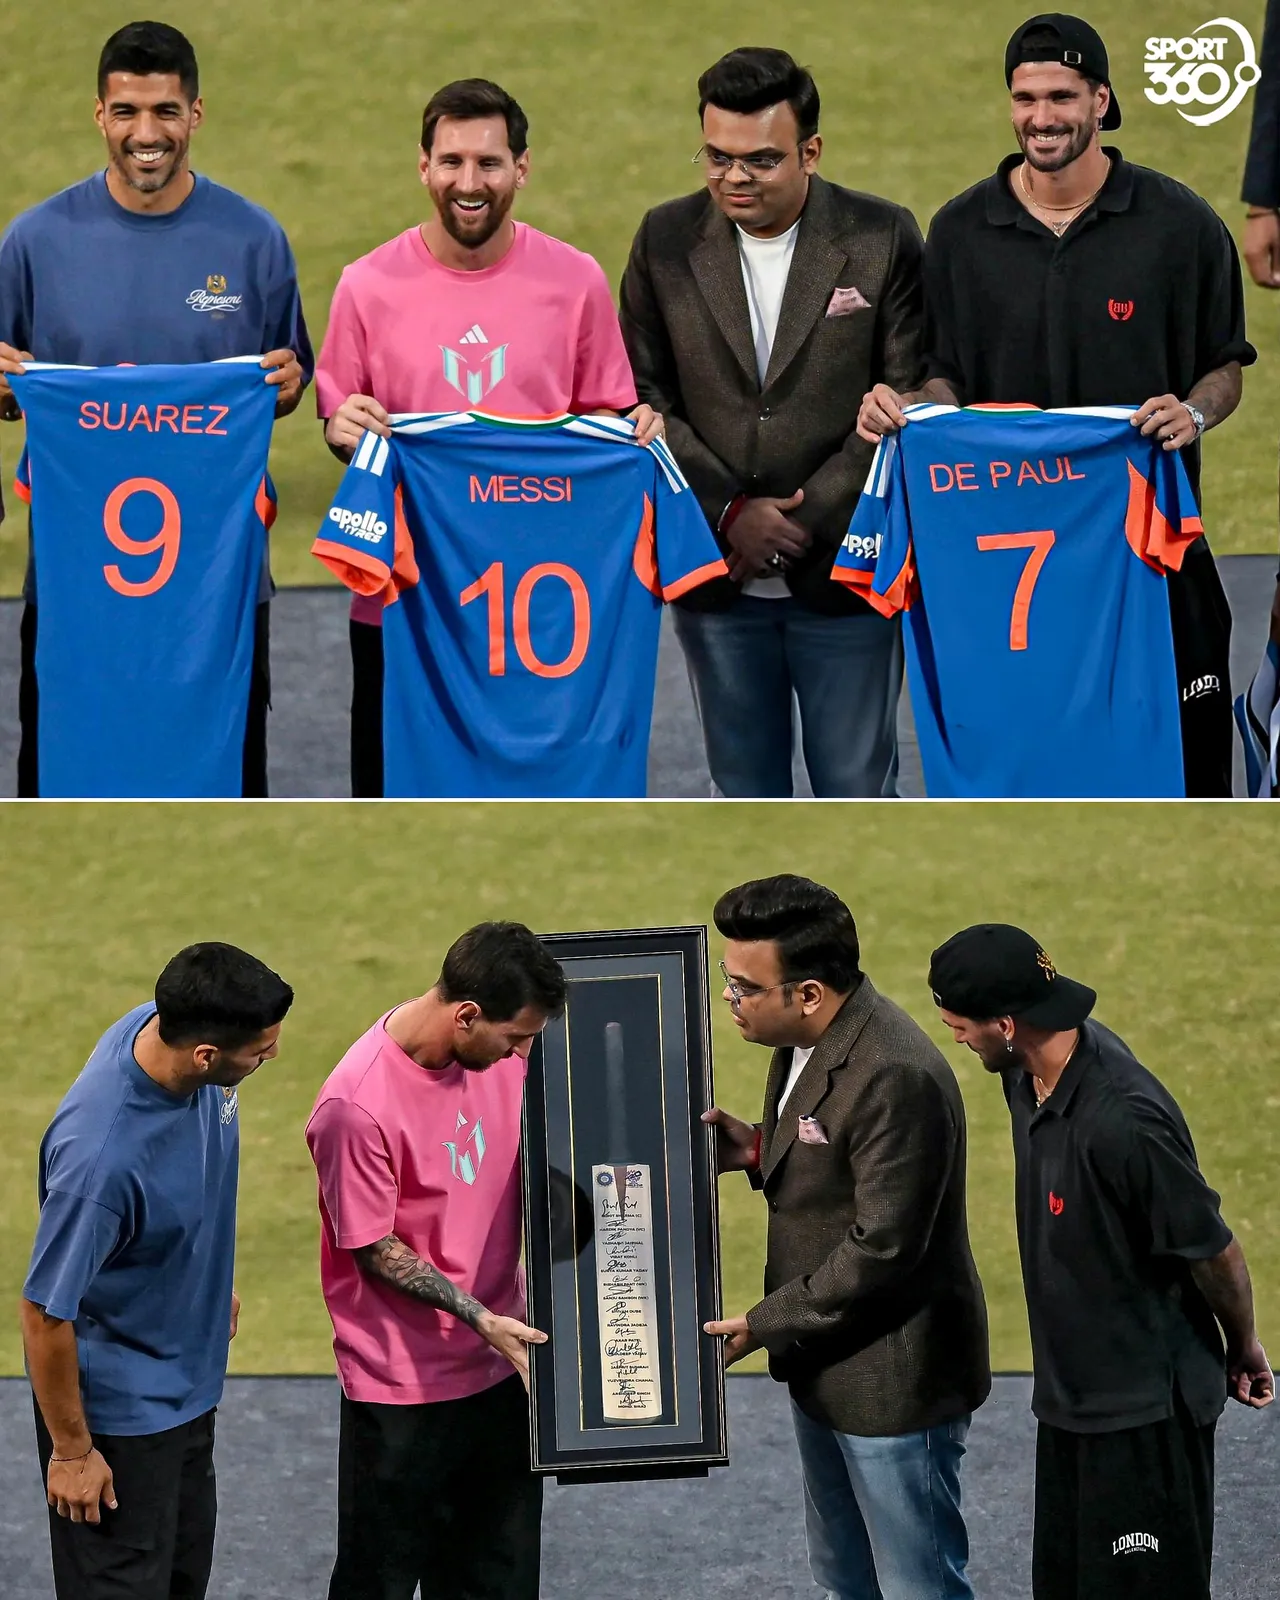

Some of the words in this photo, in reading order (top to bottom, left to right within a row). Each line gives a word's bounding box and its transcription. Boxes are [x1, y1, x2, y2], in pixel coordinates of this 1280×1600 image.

[78, 401, 230, 435] SUAREZ
[469, 475, 572, 503] MESSI
[929, 463, 980, 492] DE
[989, 456, 1086, 489] PAUL
[103, 477, 181, 597] 9
[329, 507, 388, 535] apollo
[976, 529, 1056, 650] 7
[460, 561, 591, 678] 10
[1112, 1532, 1159, 1555] LONDON
